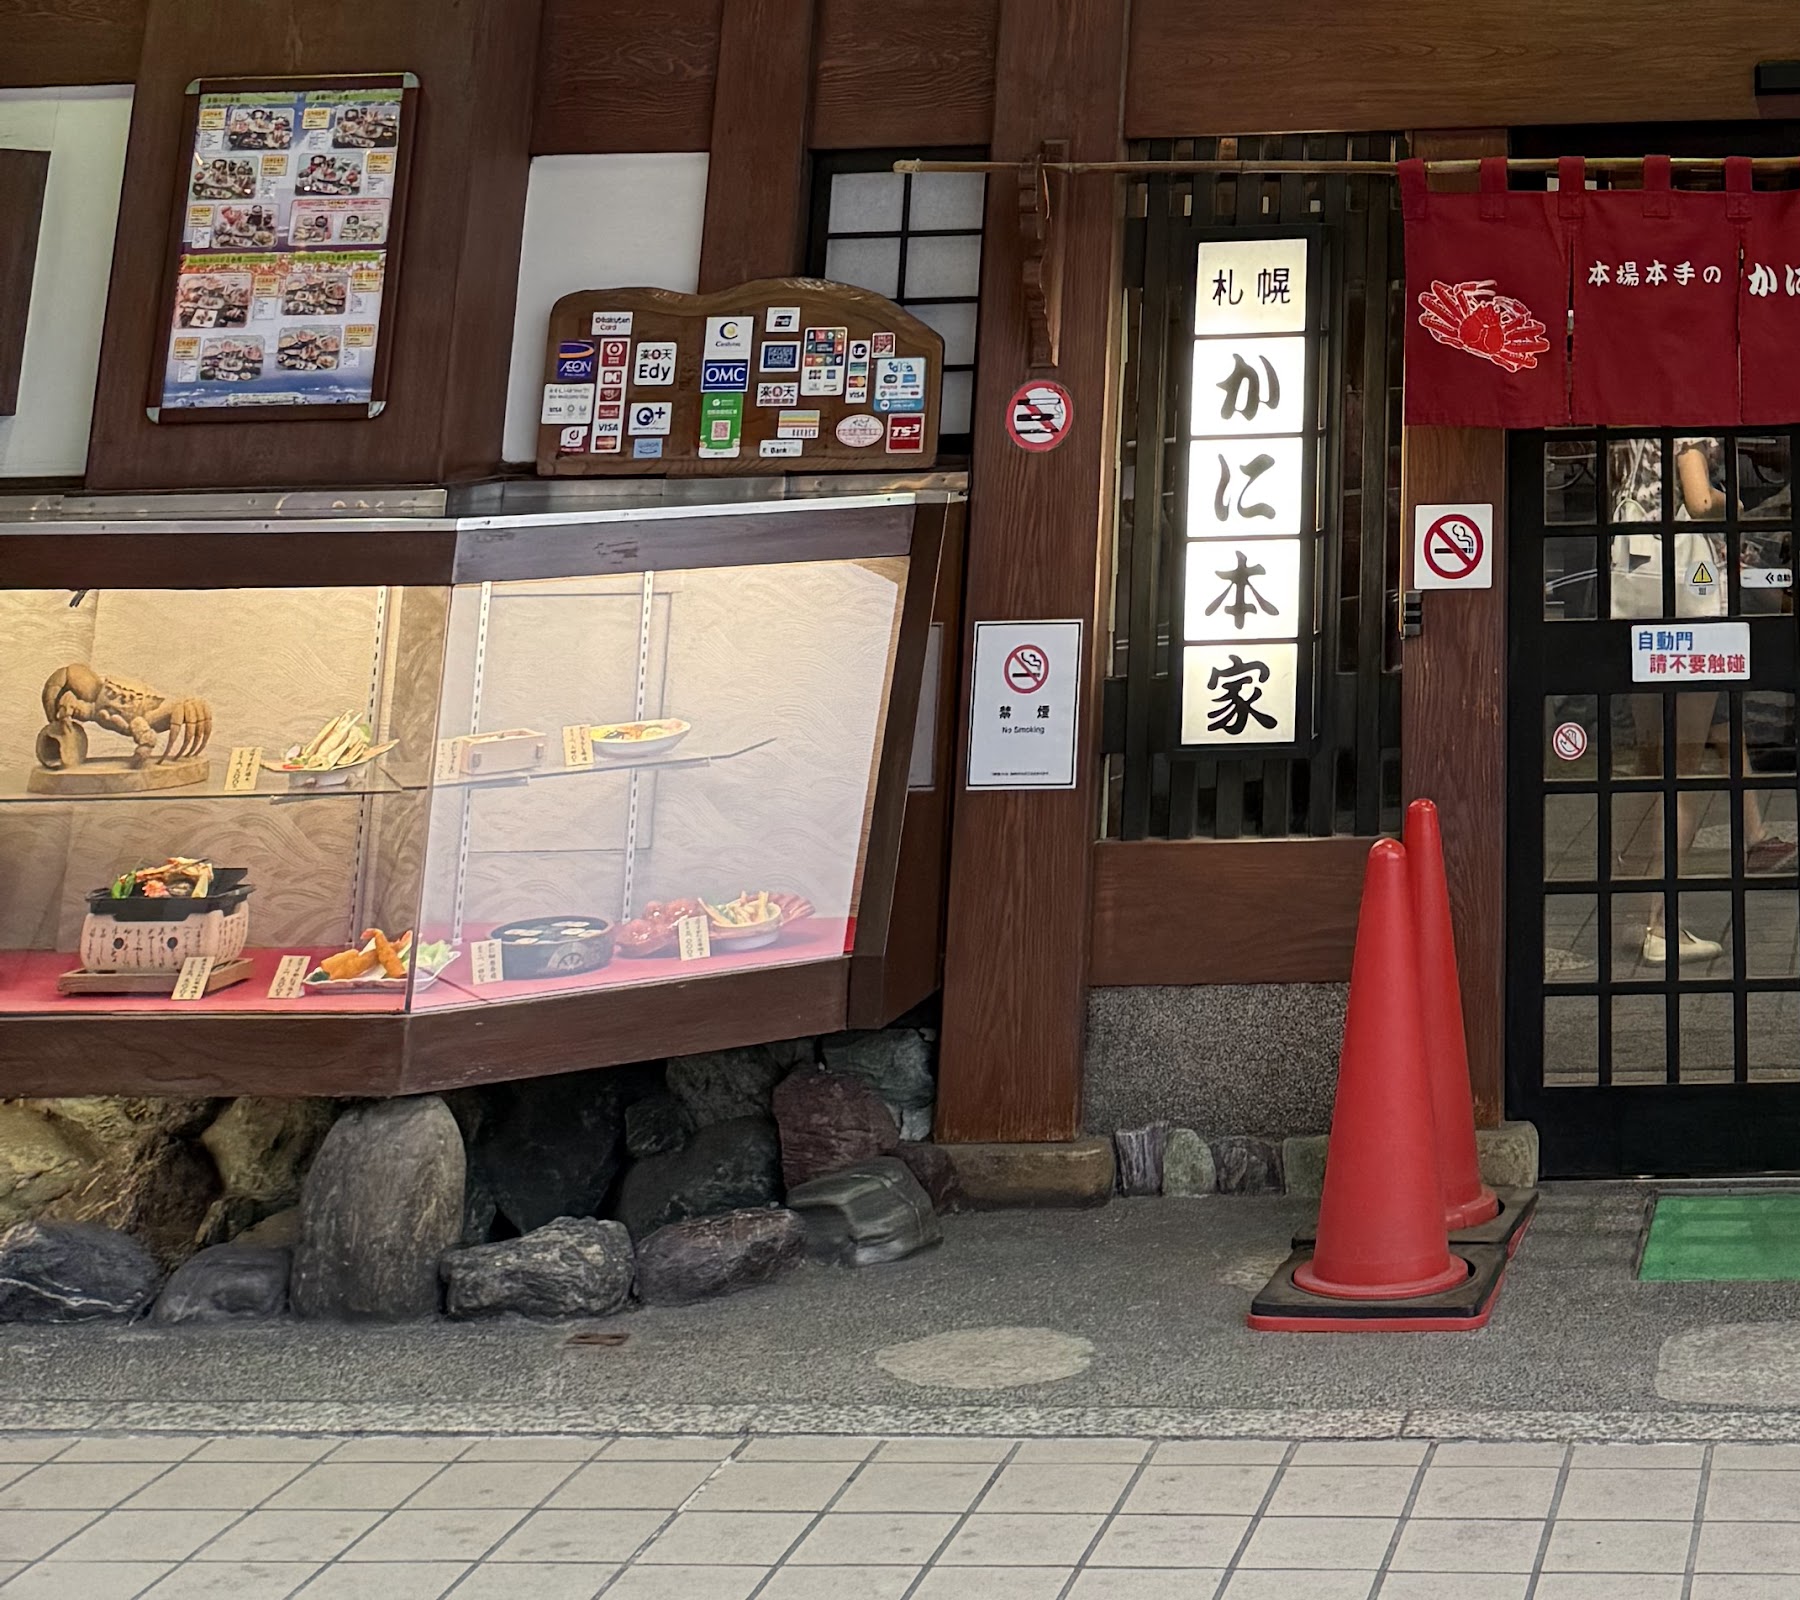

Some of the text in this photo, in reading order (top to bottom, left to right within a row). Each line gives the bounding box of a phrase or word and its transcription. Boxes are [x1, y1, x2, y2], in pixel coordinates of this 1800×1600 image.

[1588, 259, 1722, 287] 本場本手の
[1212, 267, 1291, 307] 札幌
[638, 363, 671, 381] Edy
[705, 367, 746, 382] OMC
[599, 423, 619, 431] VISA
[1204, 352, 1280, 736] かに本家
[1638, 630, 1693, 651] 自動門
[1649, 653, 1746, 673] 請不要触碰
[999, 705, 1050, 719] 禁煙
[1002, 726, 1045, 734] No Smoking
